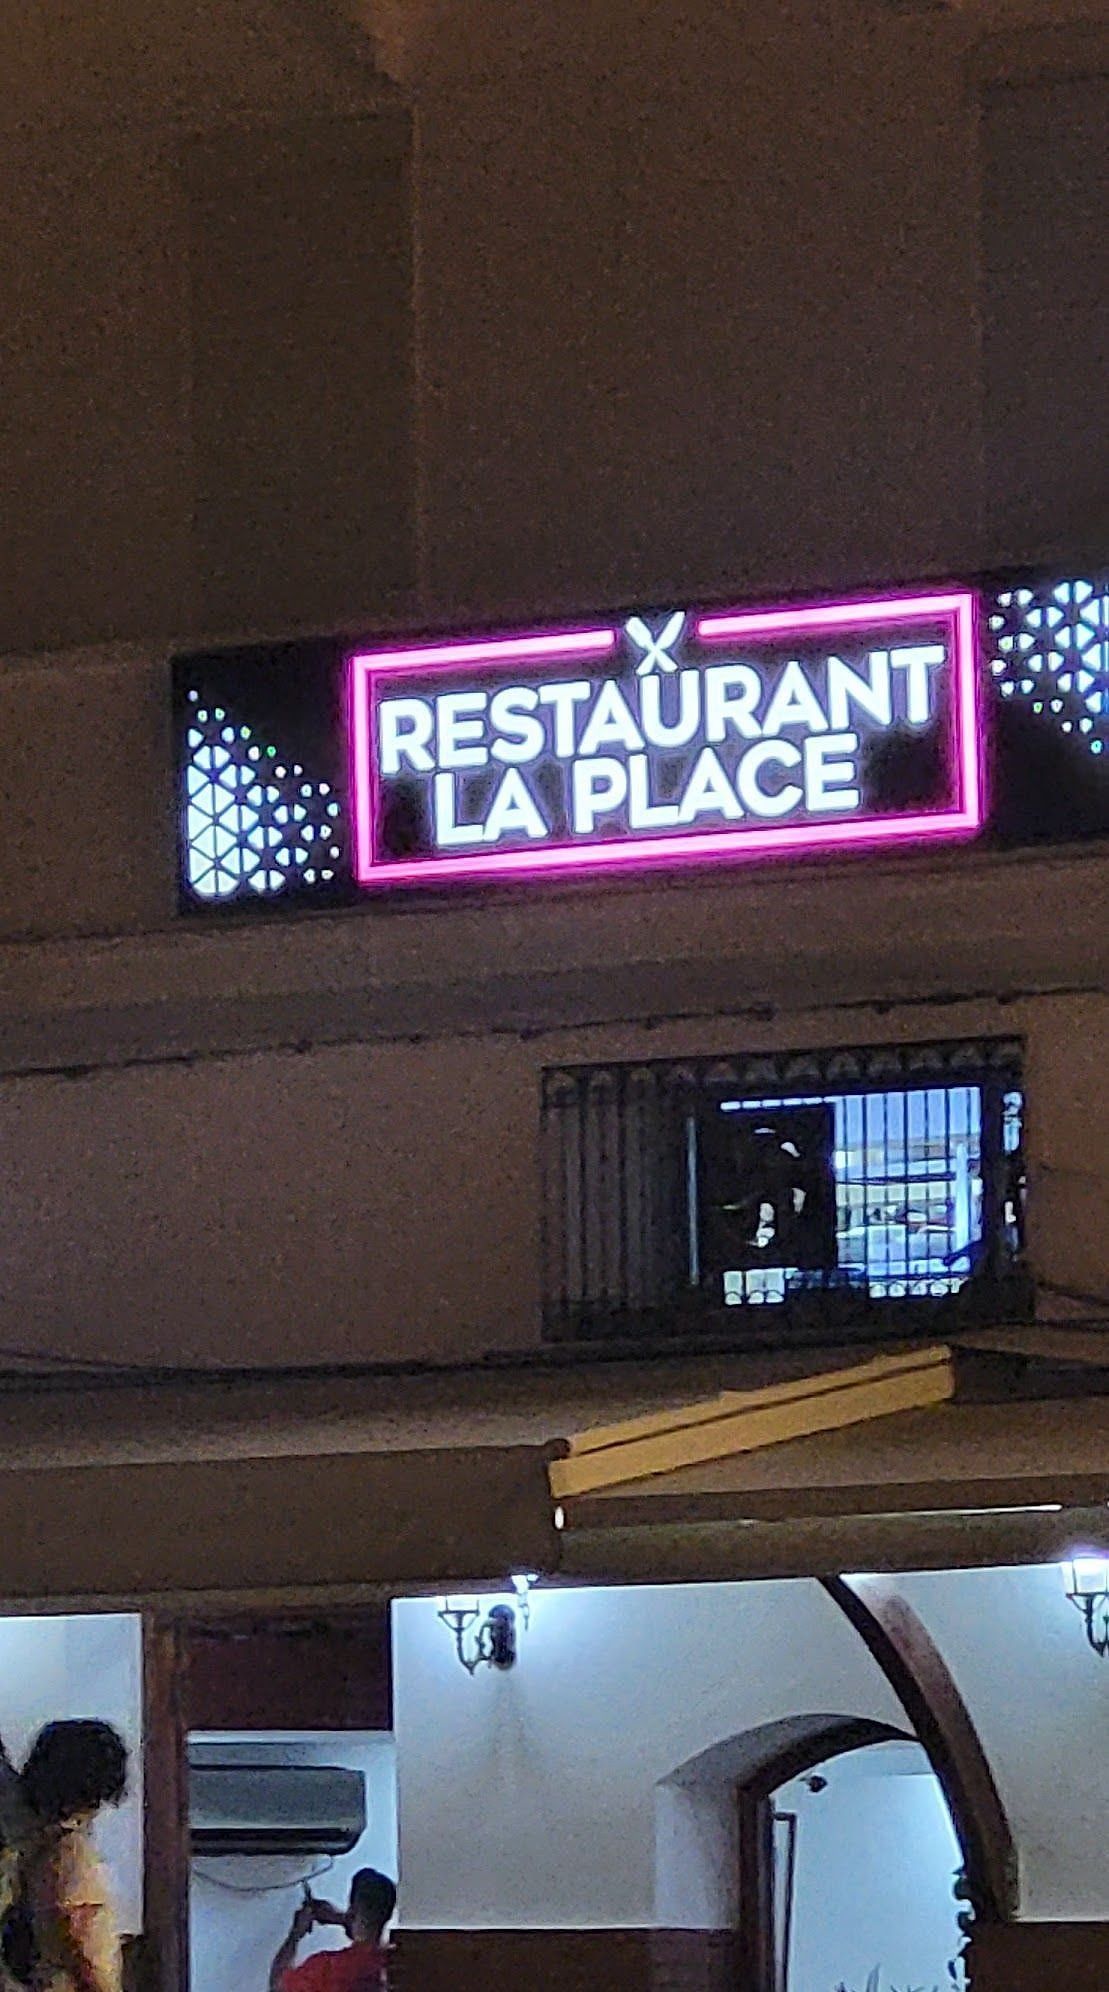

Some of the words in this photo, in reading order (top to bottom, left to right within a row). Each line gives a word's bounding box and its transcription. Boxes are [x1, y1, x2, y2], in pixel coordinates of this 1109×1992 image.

[378, 644, 946, 775] RESTAURANT
[434, 767, 549, 847] LA
[572, 732, 861, 835] PLACE
